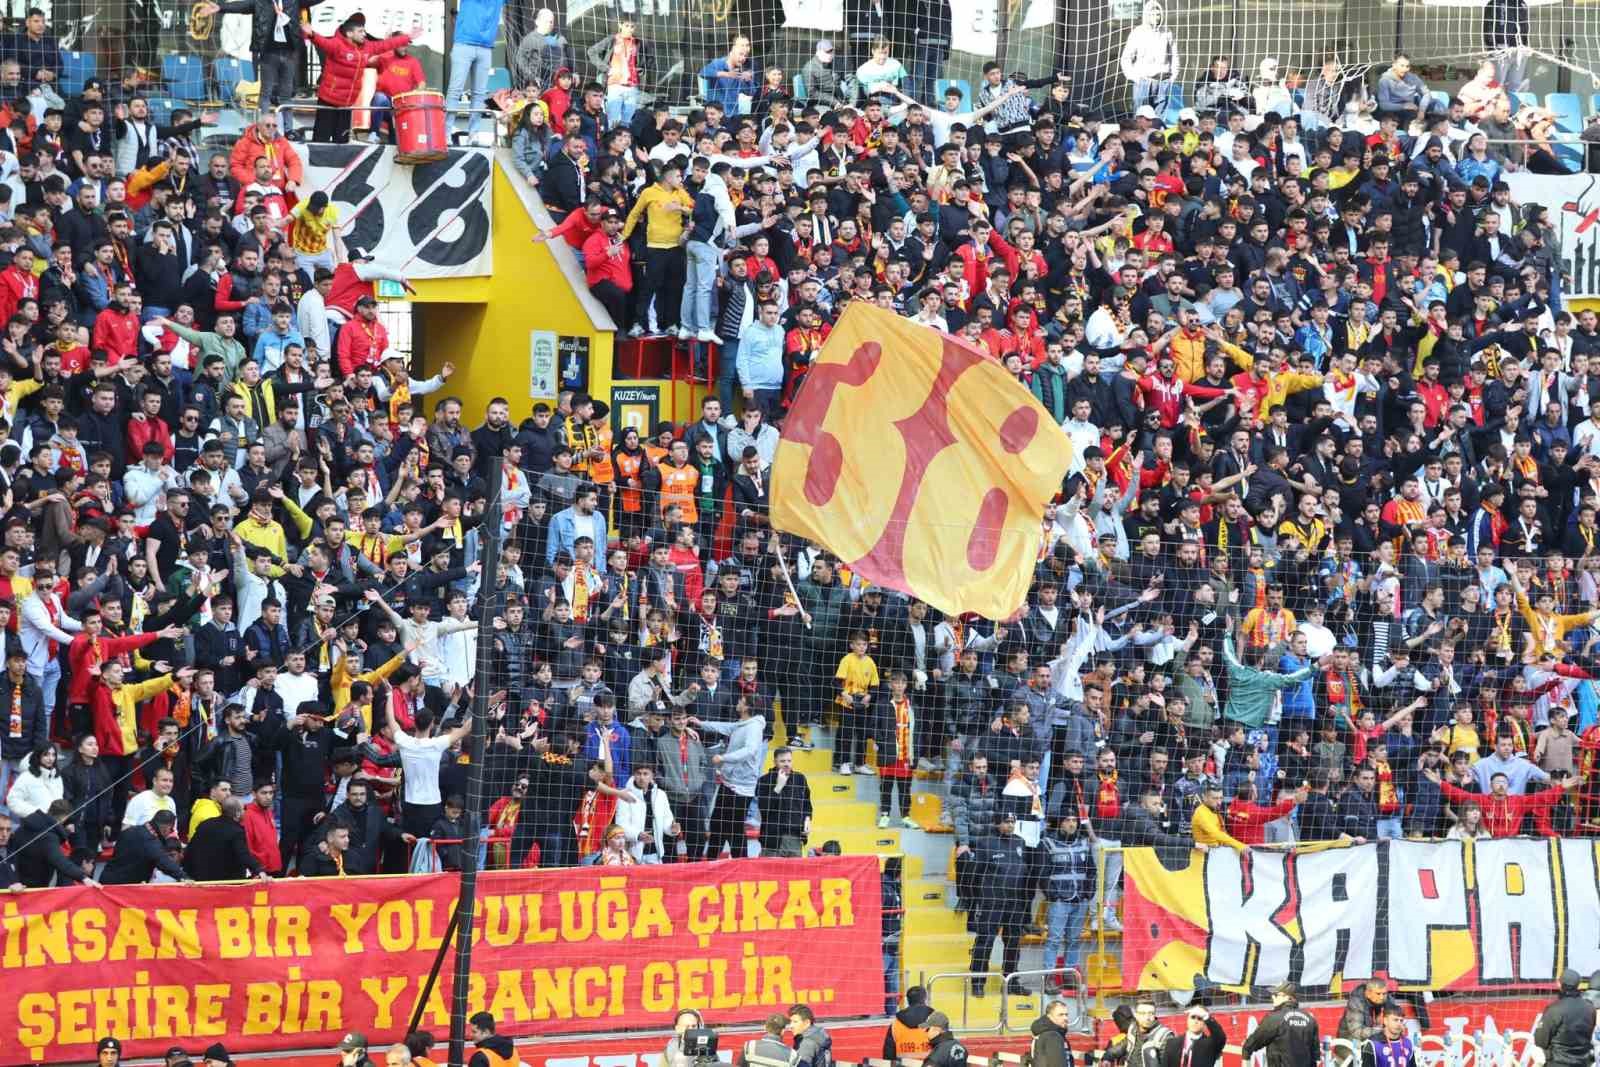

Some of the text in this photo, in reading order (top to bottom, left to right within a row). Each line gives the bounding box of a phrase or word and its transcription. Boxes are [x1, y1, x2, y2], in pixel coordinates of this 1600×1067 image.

[307, 144, 490, 266] 38
[769, 300, 1073, 623] 38
[2, 902, 203, 969] İNSAN
[214, 891, 312, 959] BİR
[687, 878, 856, 948] ÇIKAR
[17, 971, 231, 1061] ŞEHİRE
[243, 966, 343, 1036] BİR
[642, 941, 835, 1014] GELİR...
